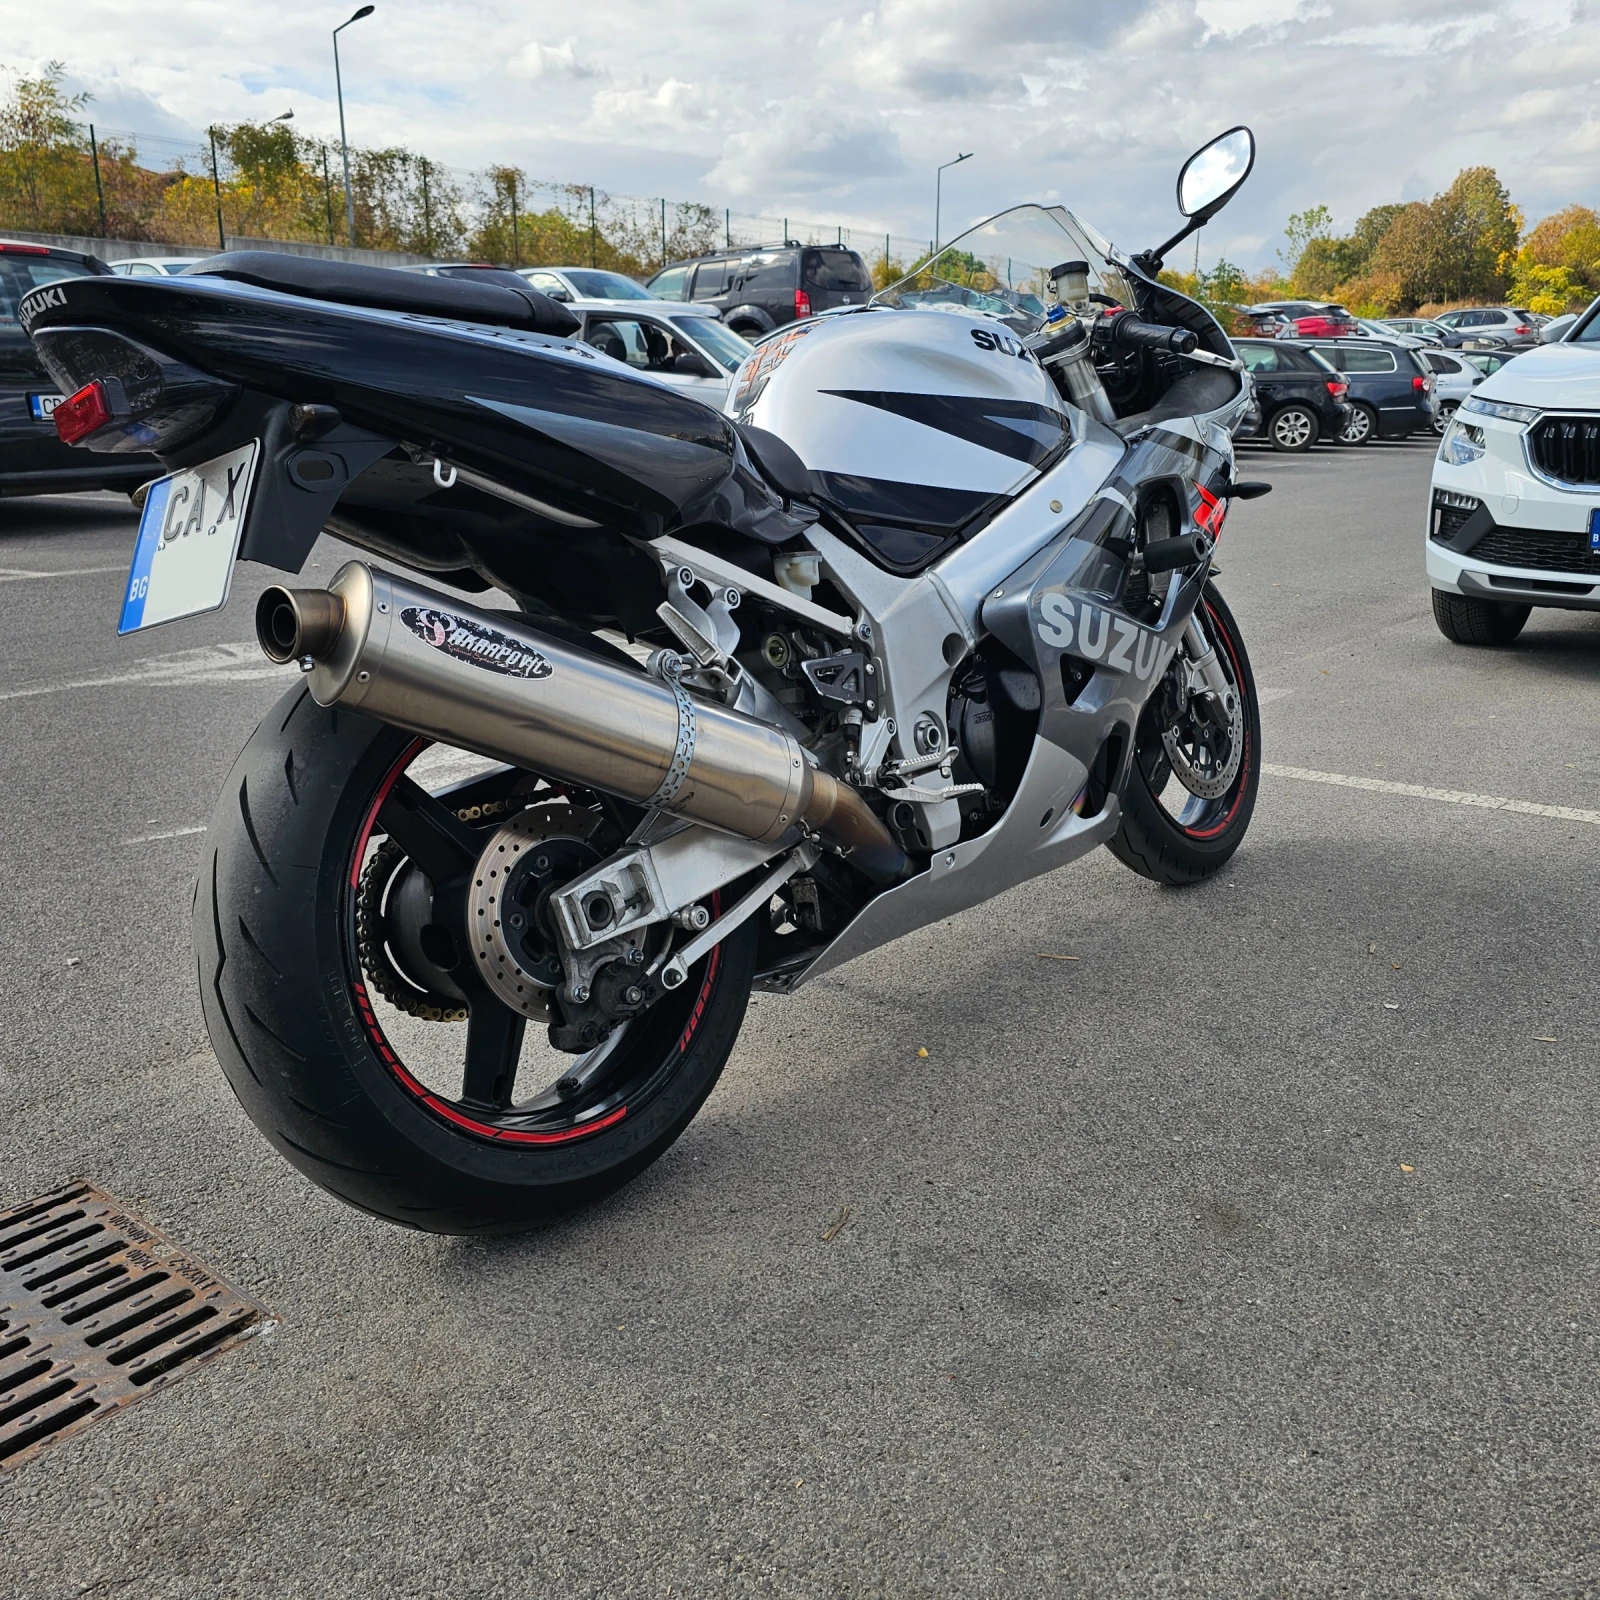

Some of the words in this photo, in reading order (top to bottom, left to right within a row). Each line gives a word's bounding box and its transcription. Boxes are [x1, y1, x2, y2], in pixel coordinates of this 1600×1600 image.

[164, 478, 207, 543] CA
[217, 462, 248, 525] X
[129, 576, 148, 602] BG
